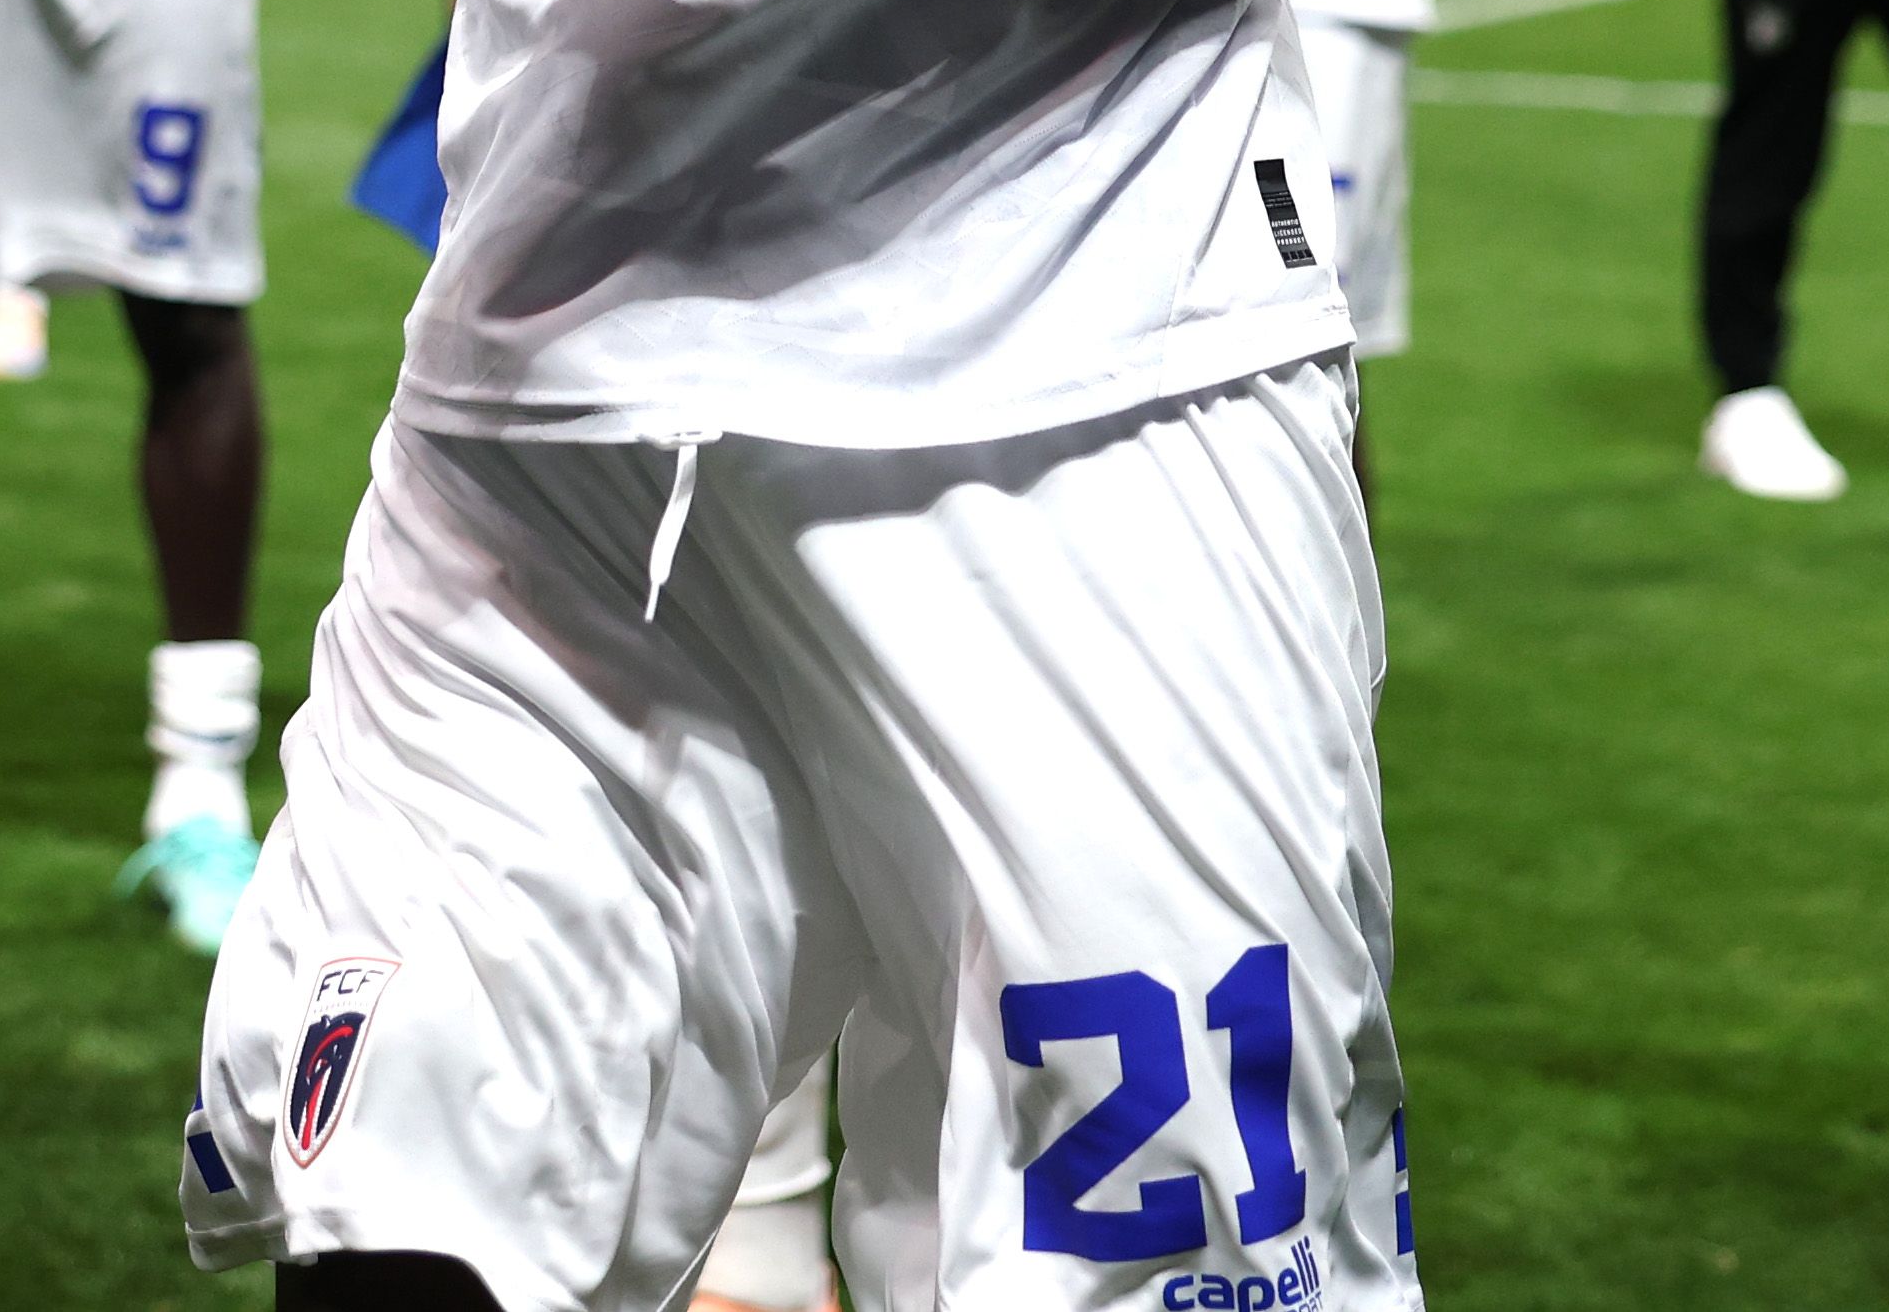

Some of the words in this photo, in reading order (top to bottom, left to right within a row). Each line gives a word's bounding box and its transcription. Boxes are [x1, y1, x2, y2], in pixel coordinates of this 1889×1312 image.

[132, 102, 206, 216] 9
[1273, 227, 1302, 238] LICENSED
[316, 968, 385, 1001] FCF
[1000, 942, 1307, 1263] 21
[1162, 1235, 1320, 1312] capelli
